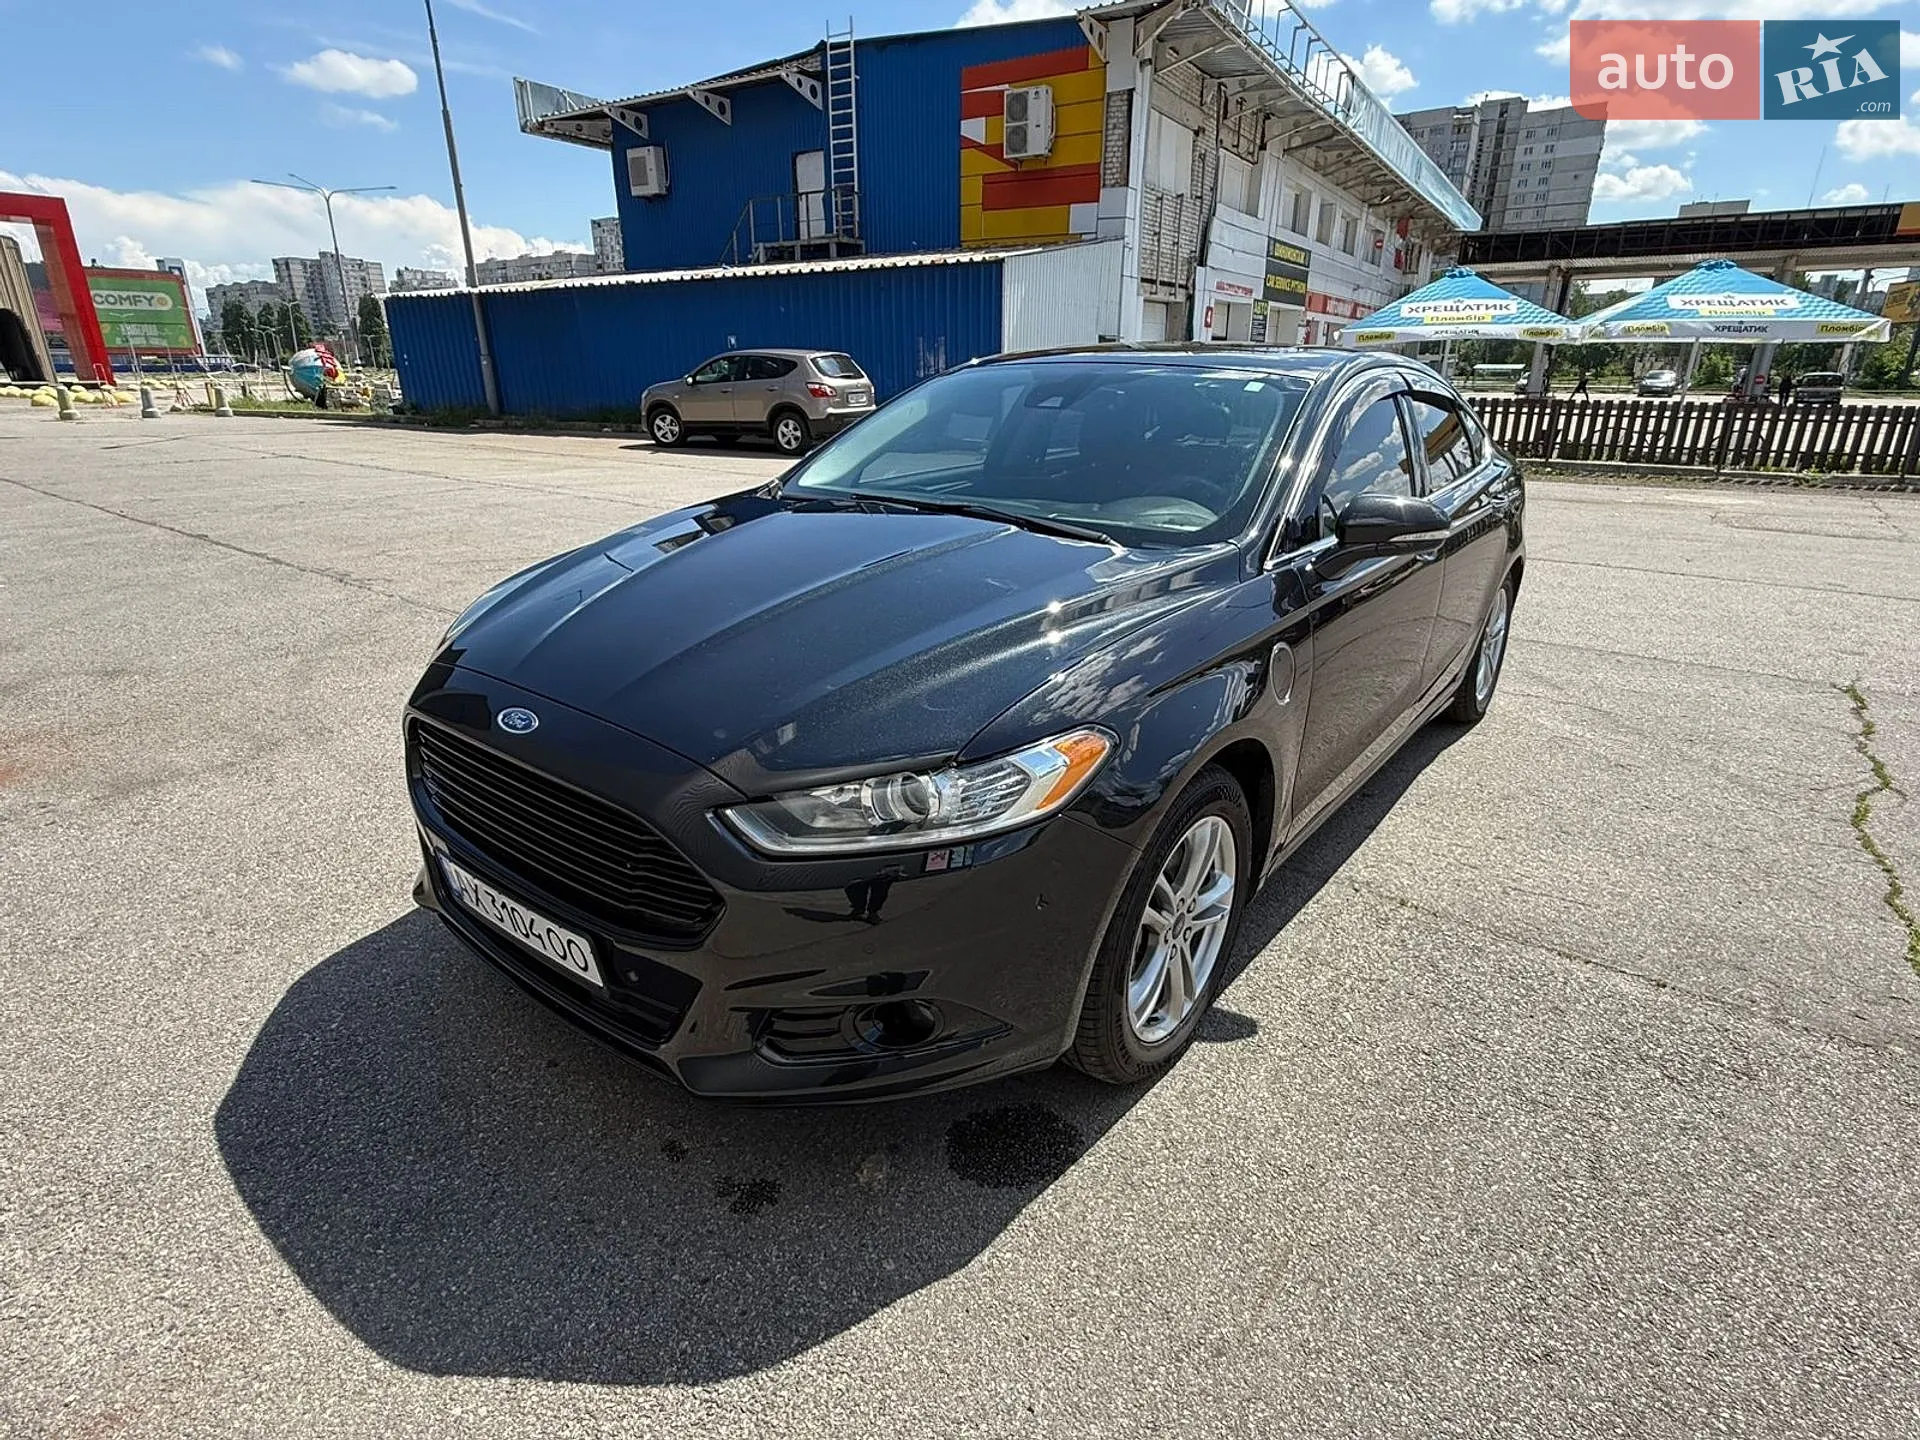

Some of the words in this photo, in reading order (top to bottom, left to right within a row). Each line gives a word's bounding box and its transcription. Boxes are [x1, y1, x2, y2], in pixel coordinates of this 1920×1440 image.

[93, 293, 155, 307] COMFY
[1680, 298, 1789, 308] ХРЕЩАТИК
[1408, 303, 1511, 314] ХРЕЩАТИК
[1430, 314, 1485, 322] Пломбір
[1713, 324, 1769, 334] ХРЕЩАТИК
